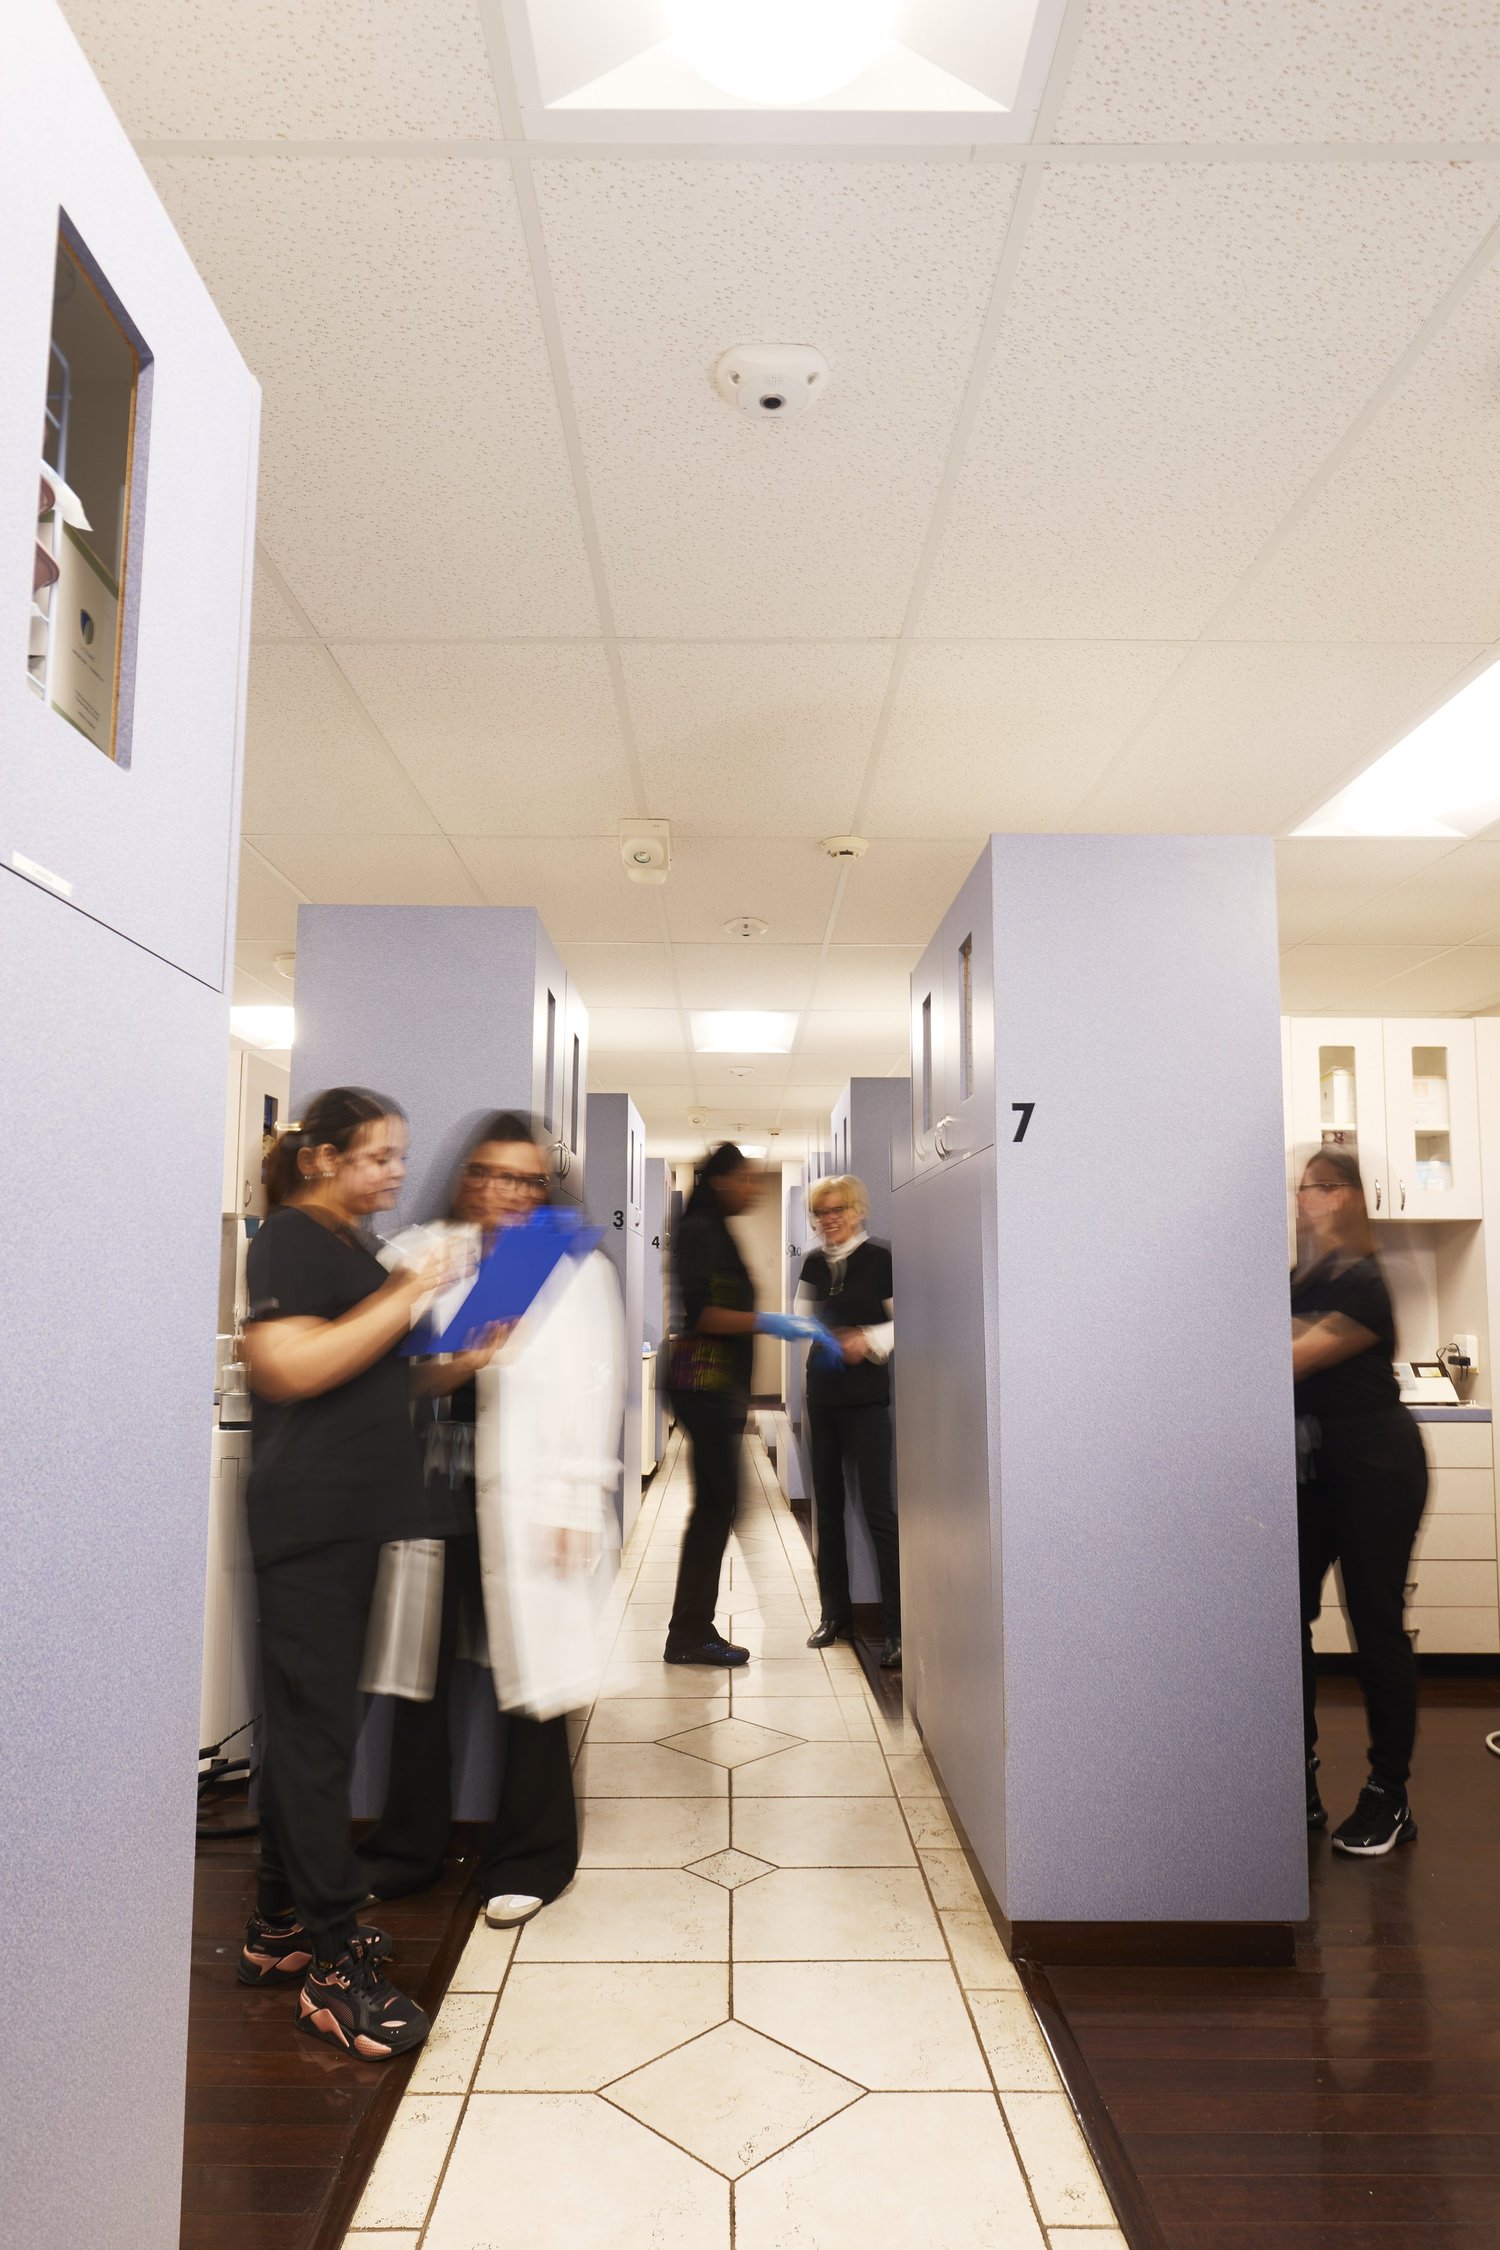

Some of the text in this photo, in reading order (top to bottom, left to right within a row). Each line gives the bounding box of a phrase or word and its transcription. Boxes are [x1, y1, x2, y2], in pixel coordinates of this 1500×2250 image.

[1011, 1102, 1036, 1142] 7
[612, 1210, 624, 1228] 3
[651, 1236, 660, 1249] 4
